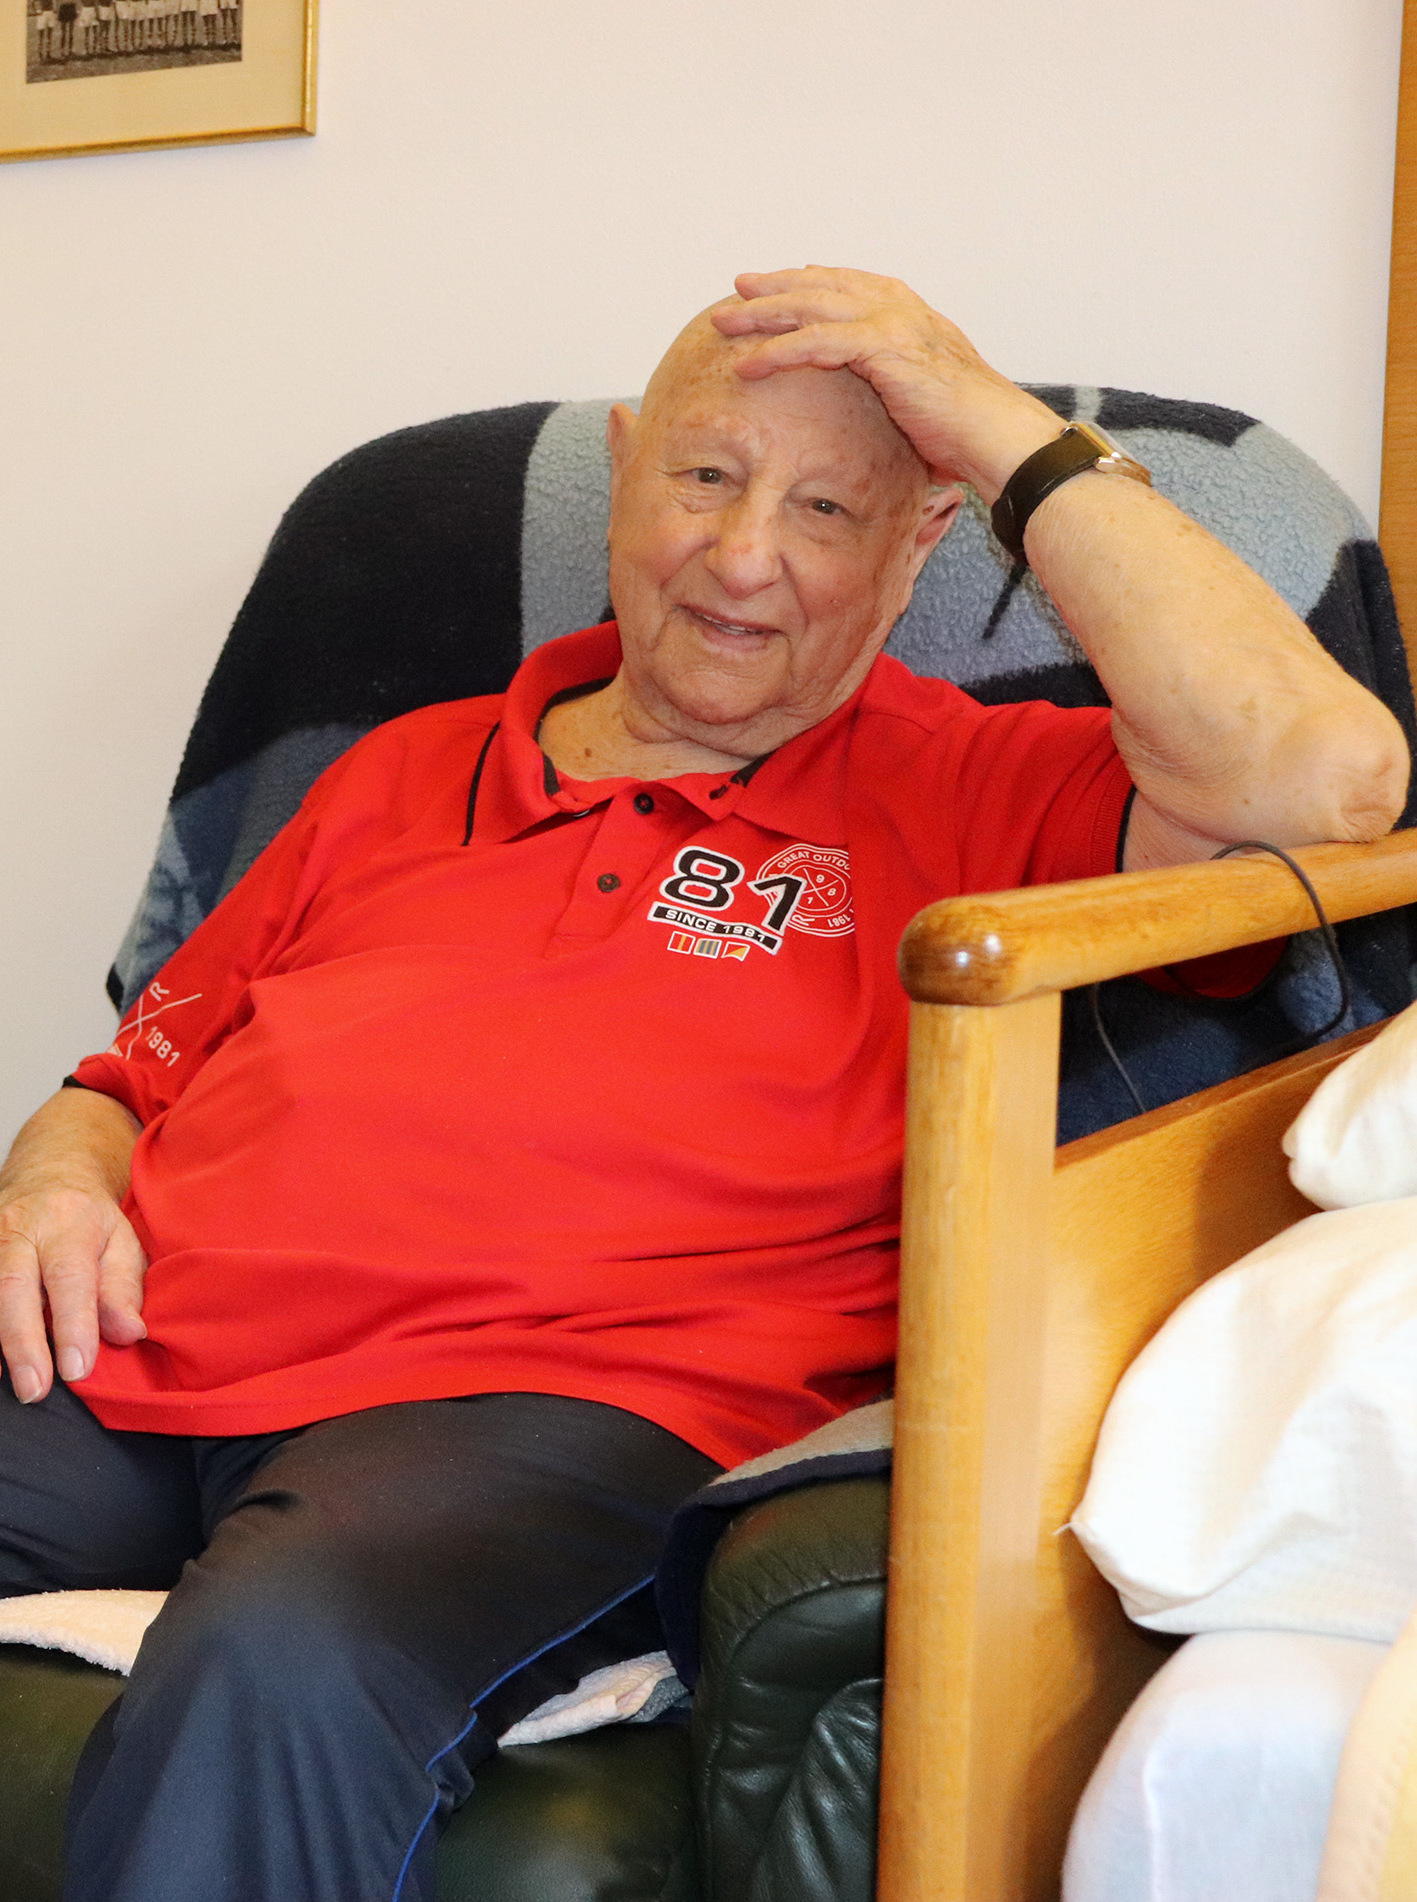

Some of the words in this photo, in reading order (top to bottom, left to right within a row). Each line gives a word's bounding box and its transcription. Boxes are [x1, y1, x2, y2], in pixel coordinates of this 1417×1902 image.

[777, 851, 810, 868] GREAT
[659, 845, 807, 936] 81
[665, 909, 717, 932] SINCE
[723, 925, 766, 942] 1981
[146, 1026, 180, 1067] 1981
